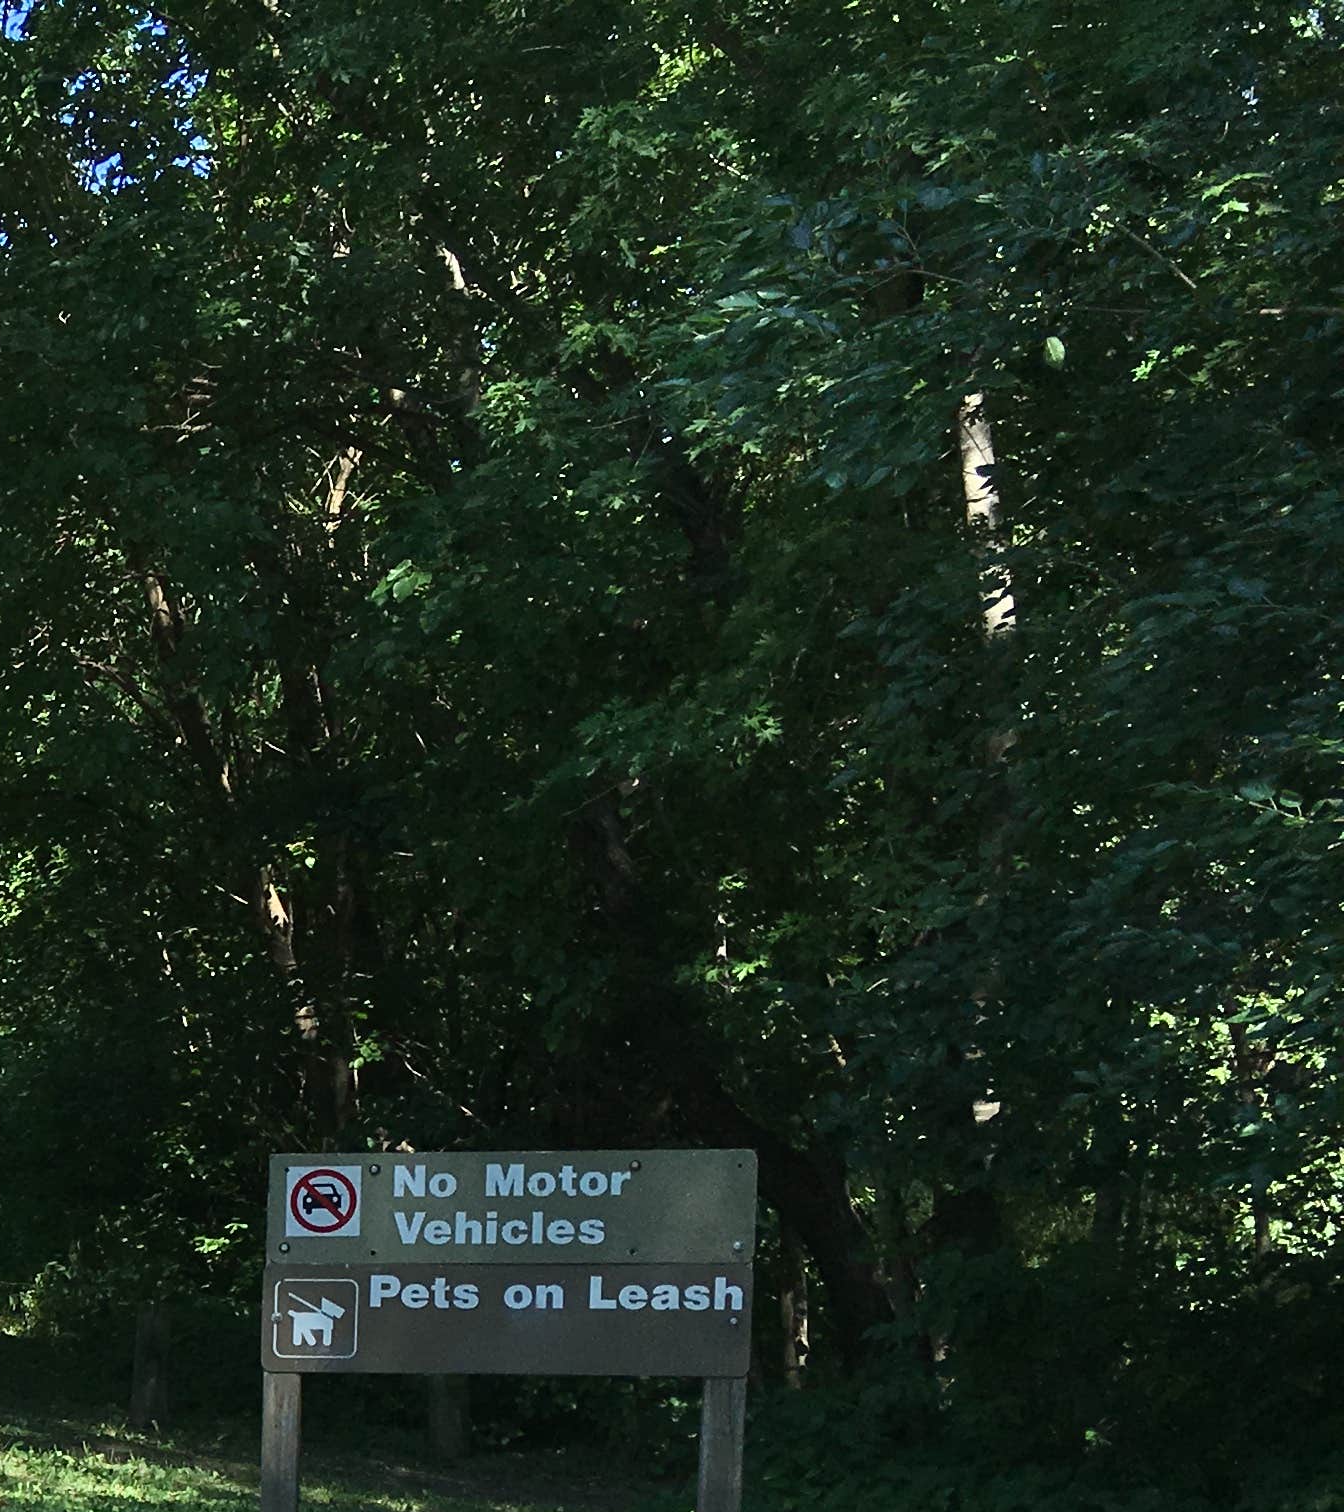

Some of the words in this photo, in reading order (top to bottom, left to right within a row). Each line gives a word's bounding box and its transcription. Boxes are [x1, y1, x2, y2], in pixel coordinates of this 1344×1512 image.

[393, 1165, 457, 1198] No
[485, 1163, 631, 1198] Motor
[393, 1211, 606, 1245] Vehicles
[368, 1275, 480, 1310] Pets
[503, 1281, 564, 1310] on
[589, 1276, 744, 1311] Leash
